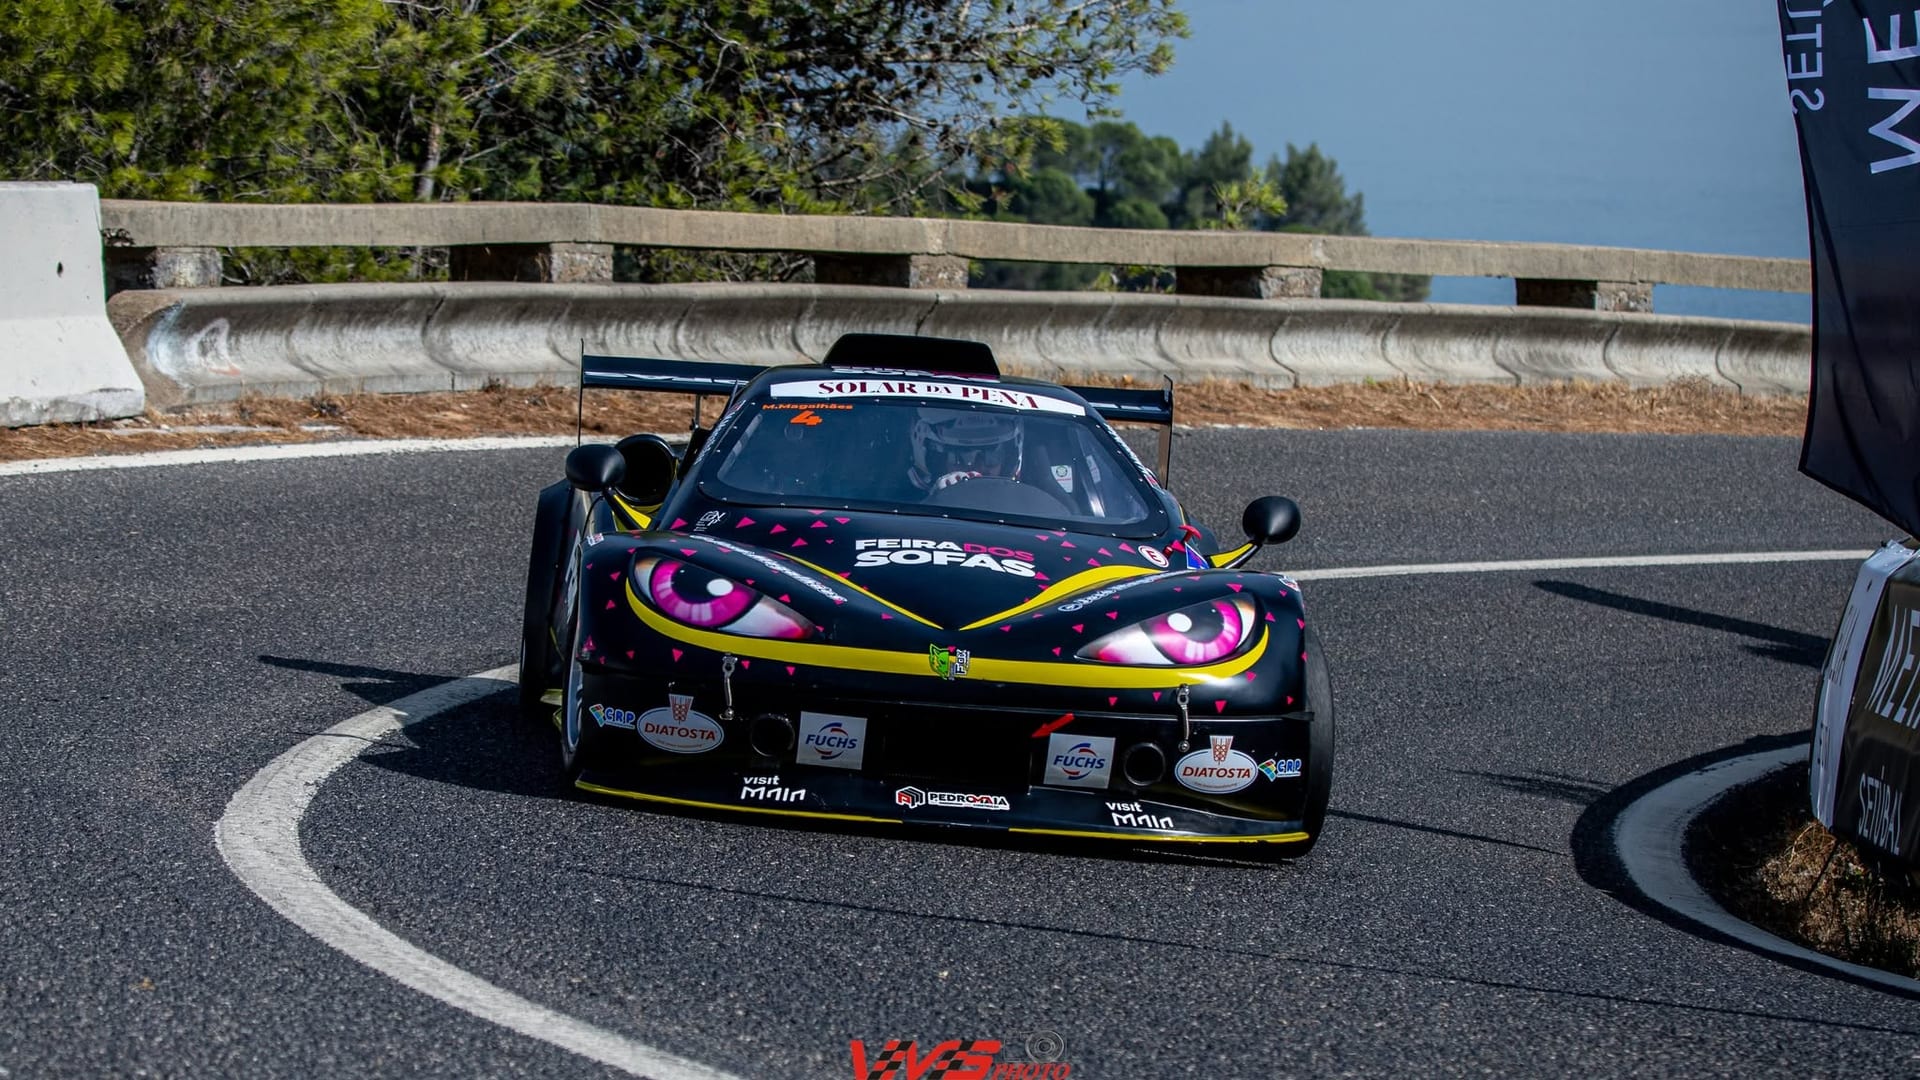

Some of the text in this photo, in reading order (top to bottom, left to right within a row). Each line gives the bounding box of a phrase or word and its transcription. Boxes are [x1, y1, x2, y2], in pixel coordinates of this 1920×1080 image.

[818, 381, 1039, 409] SOLAR DA PENA
[790, 410, 823, 426] 4
[855, 538, 1035, 561] FEIRA DOS
[854, 549, 1036, 578] SOFAS
[605, 708, 635, 724] CRP
[644, 722, 716, 741] DIATOSTA
[805, 733, 858, 750] FUCHS
[1053, 755, 1106, 769] FUCHS
[1276, 760, 1302, 774] CRP
[1182, 766, 1251, 779] DIATOSTA
